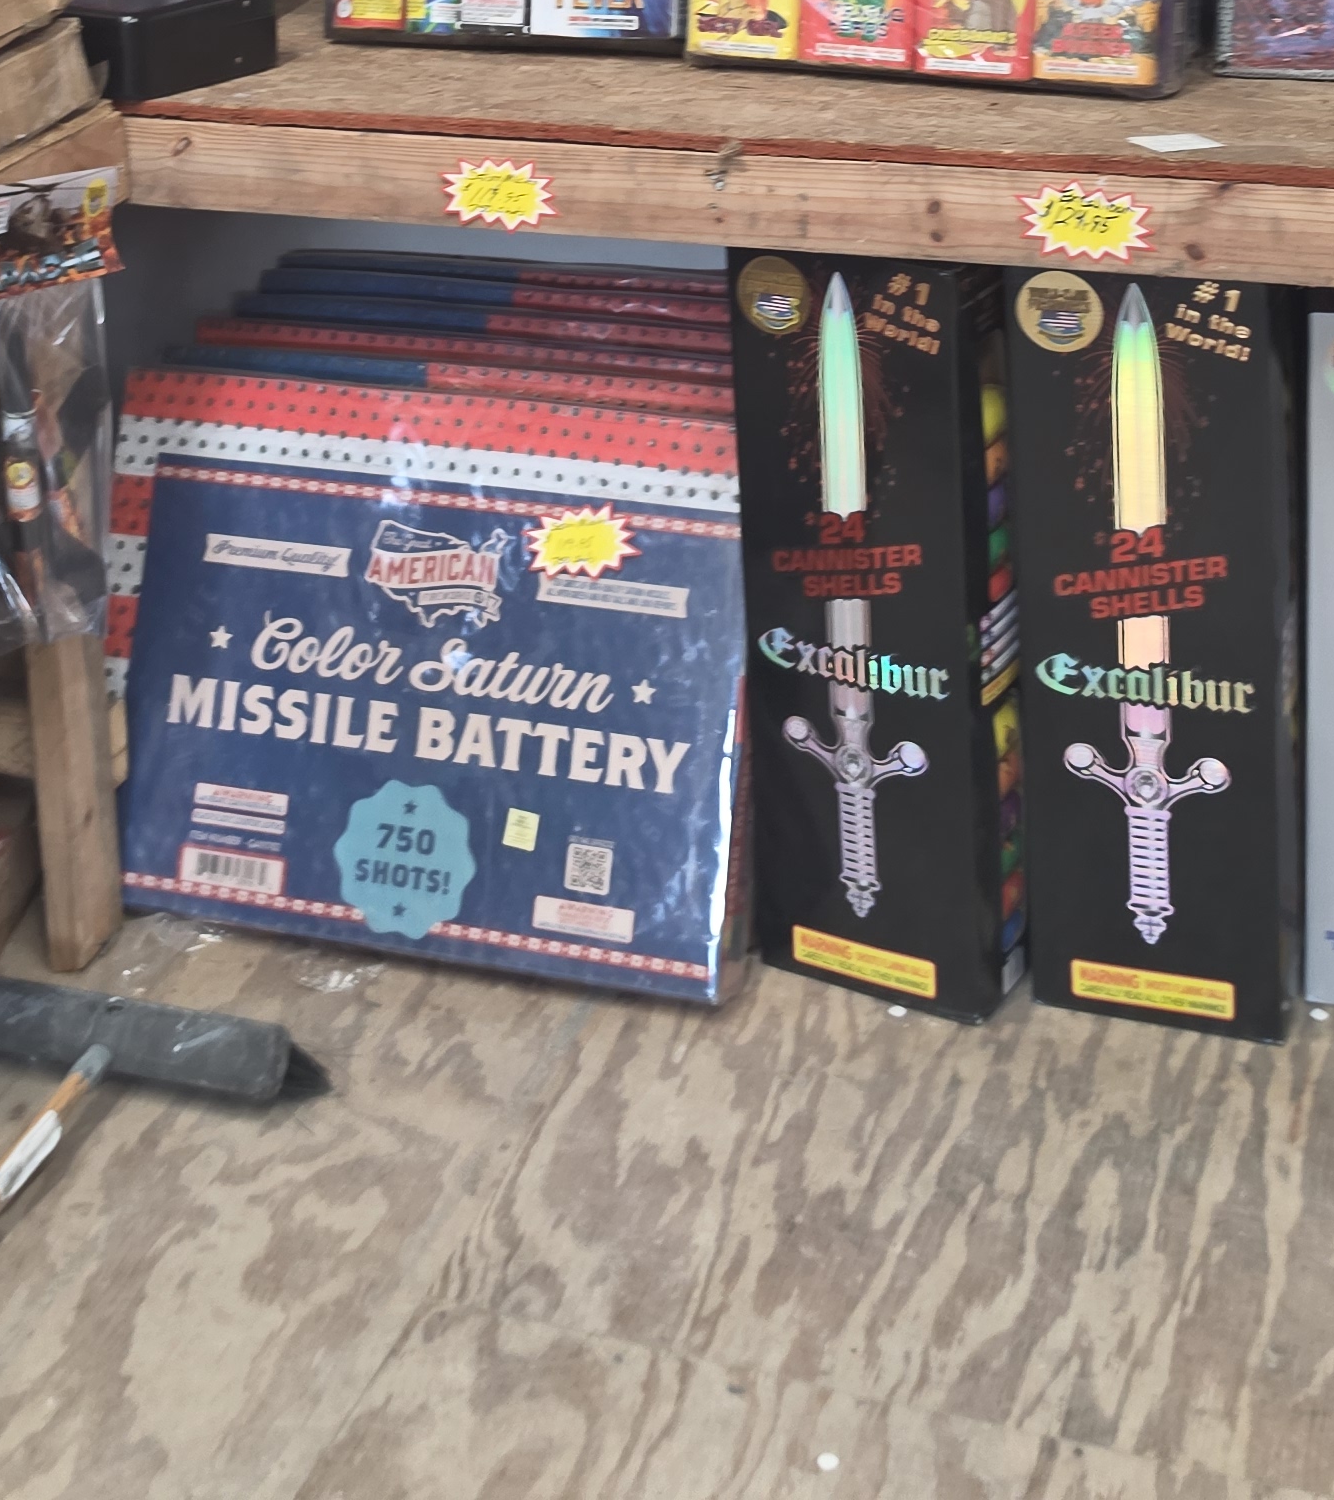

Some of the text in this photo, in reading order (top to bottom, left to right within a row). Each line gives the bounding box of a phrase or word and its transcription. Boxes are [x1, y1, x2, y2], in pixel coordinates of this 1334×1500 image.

[1173, 303, 1252, 340] in the
[1165, 321, 1252, 363] World!
[818, 513, 865, 545] 24
[1109, 527, 1165, 563] 24
[367, 552, 498, 586] AMERICAN
[771, 544, 923, 574] CANNISTER
[1053, 555, 1229, 600] CANNISTER
[801, 571, 903, 597] SHELLS
[1089, 585, 1206, 621] SHELLS
[249, 609, 616, 715] Color Saturn
[757, 626, 952, 702] Excalibur
[1034, 651, 1256, 715] Excalibur
[165, 672, 693, 796] MISSILE BATTERY
[375, 822, 437, 856] 750
[353, 856, 453, 897] SHOTS!
